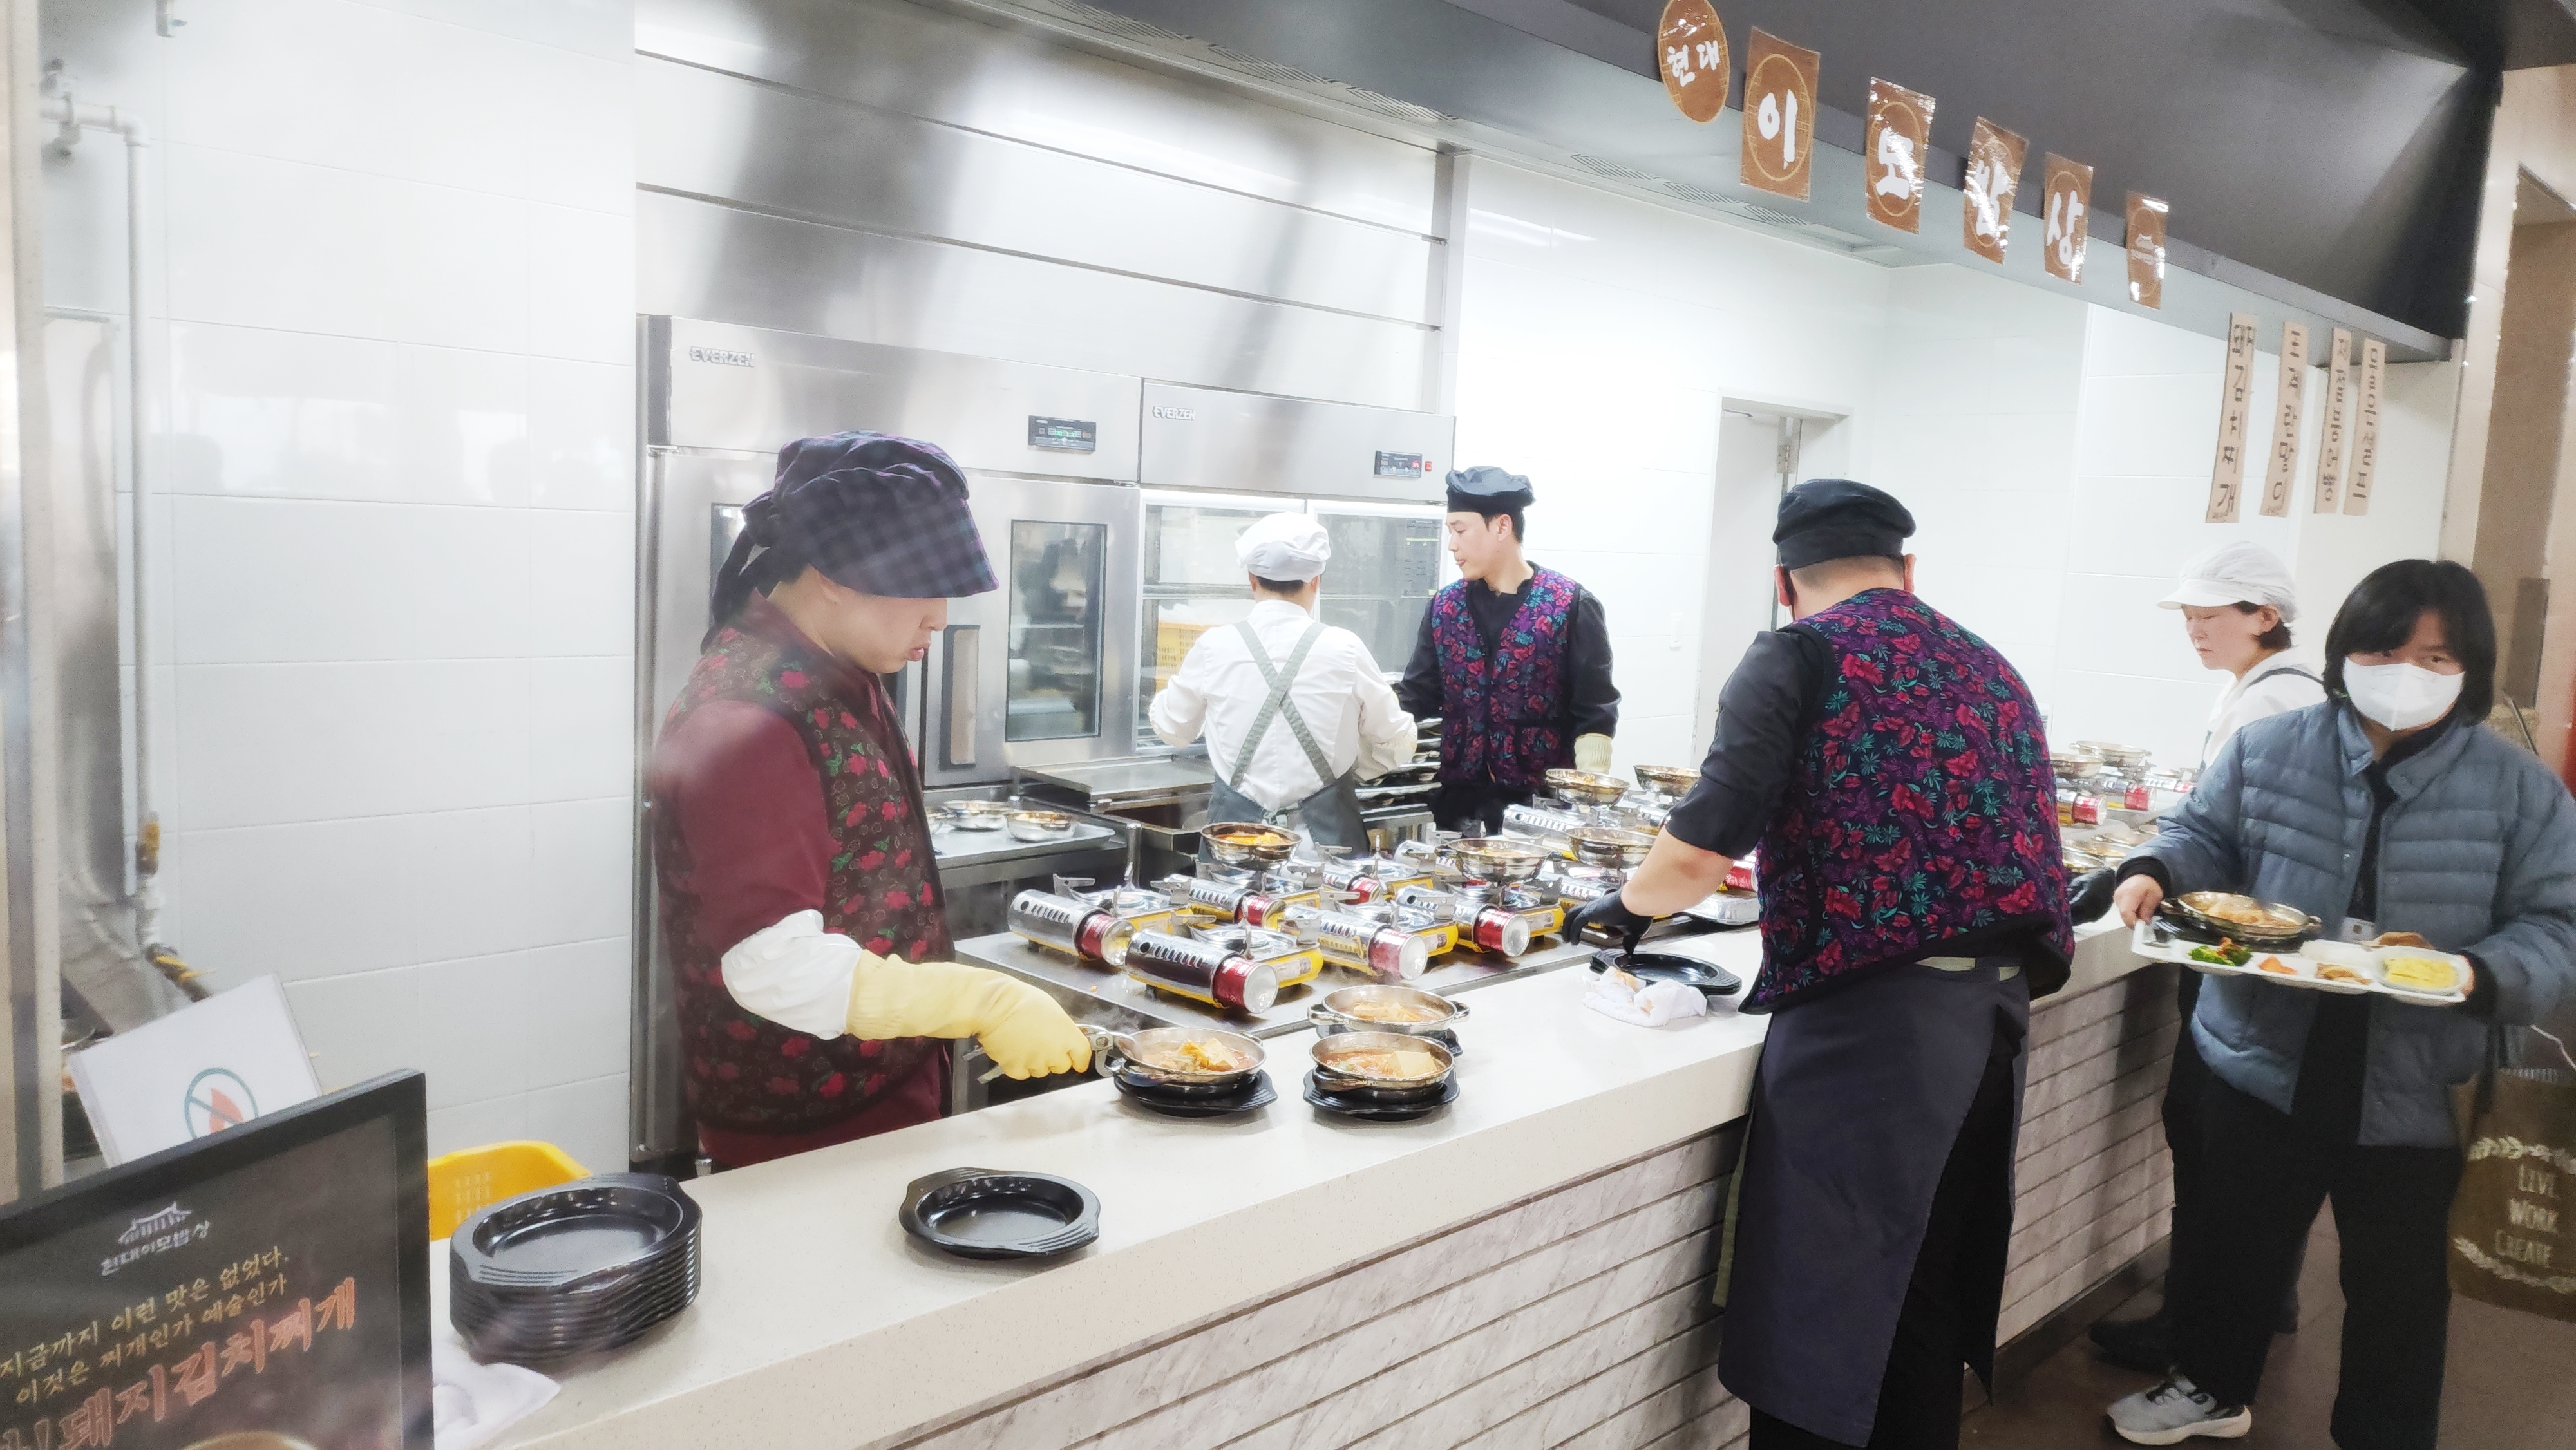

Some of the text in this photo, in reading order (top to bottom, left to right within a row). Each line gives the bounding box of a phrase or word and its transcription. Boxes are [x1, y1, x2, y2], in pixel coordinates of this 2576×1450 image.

[1667, 39, 1720, 88] 현대
[1757, 88, 1798, 169] 이
[1875, 127, 1917, 200] 모
[689, 346, 755, 368] EVERZEN
[1152, 405, 1197, 421] EVERZEN
[111, 1297, 156, 1332] 이런
[166, 1277, 210, 1312] 맛은
[16, 1272, 287, 1404] 이것은 찌개인가 예술인가
